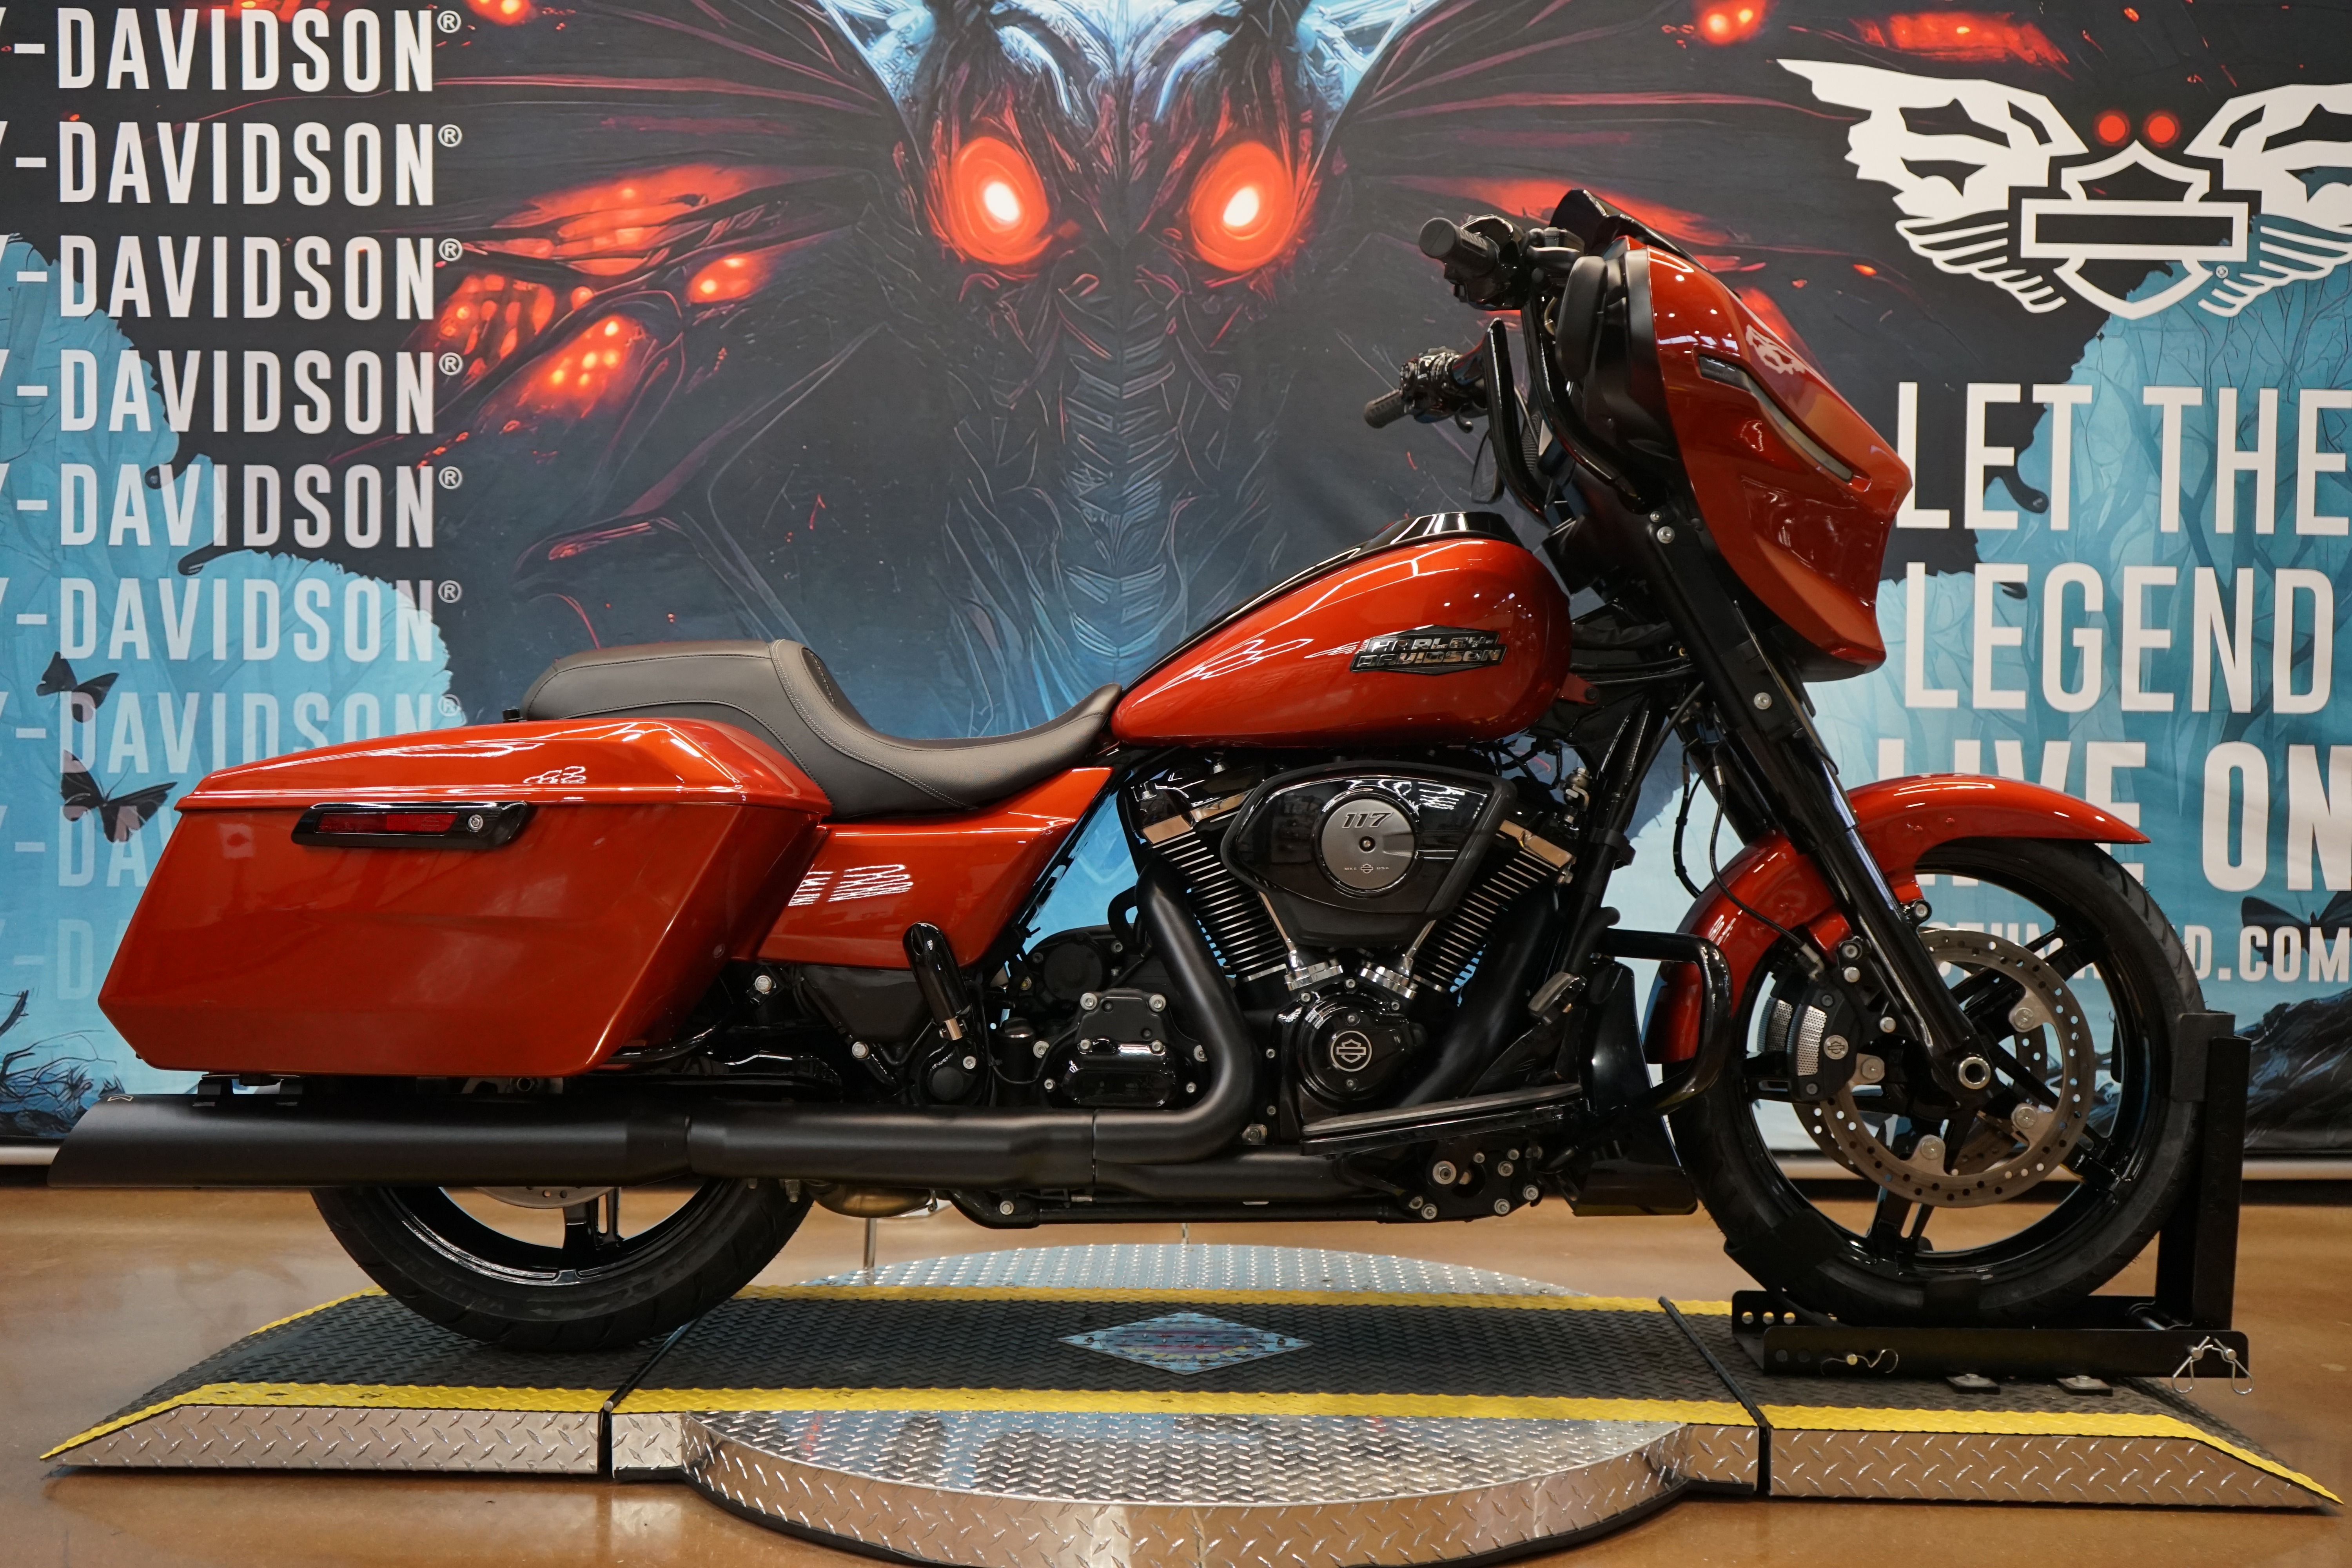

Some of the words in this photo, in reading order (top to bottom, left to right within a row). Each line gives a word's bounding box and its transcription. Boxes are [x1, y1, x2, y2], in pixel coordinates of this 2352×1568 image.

[1896, 381, 2092, 530] LET
[2143, 386, 2352, 536] THE
[1357, 649, 1501, 667] DAVIDSON
[1905, 562, 2334, 714] LEGEND
[1342, 811, 1393, 828] 117
[2202, 741, 2352, 892] ON
